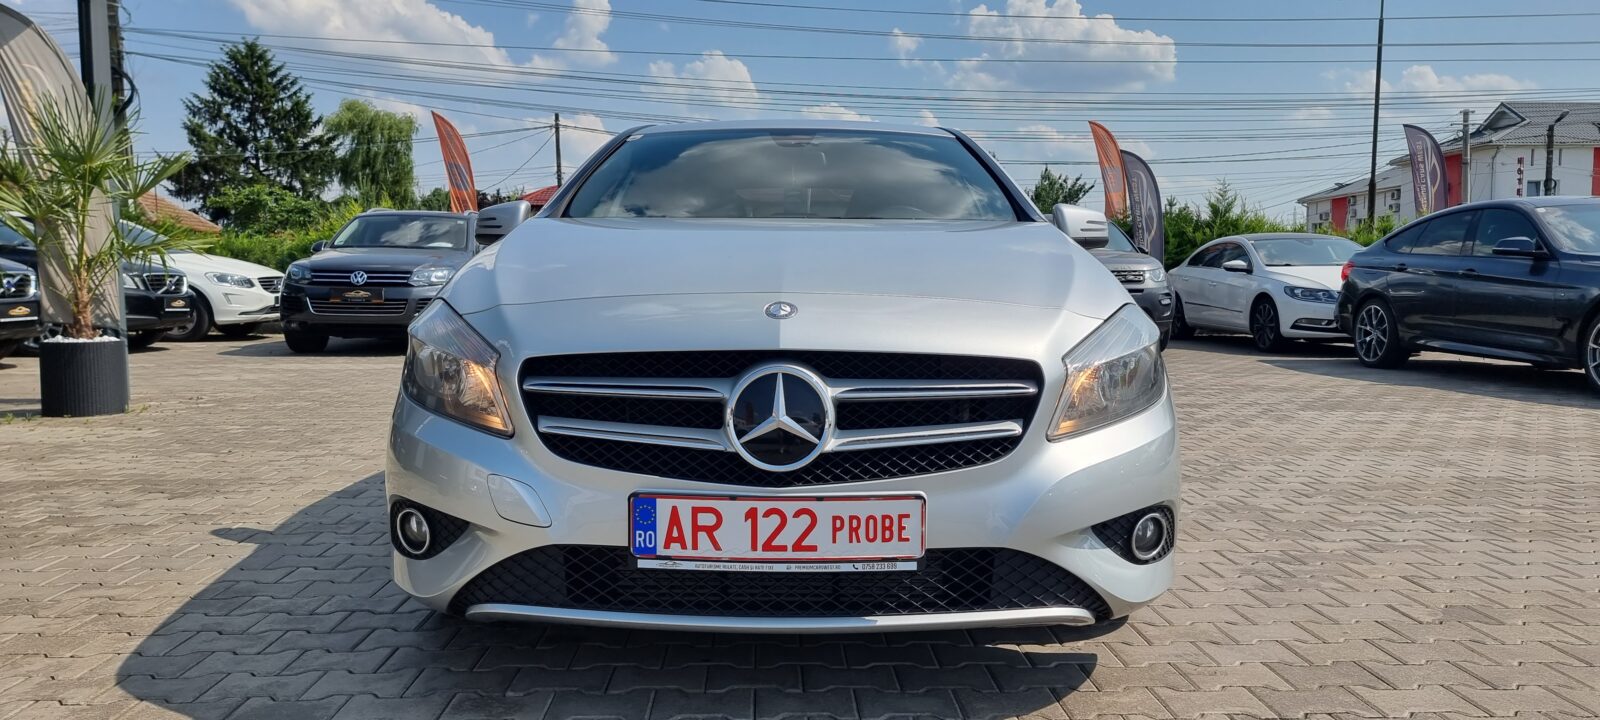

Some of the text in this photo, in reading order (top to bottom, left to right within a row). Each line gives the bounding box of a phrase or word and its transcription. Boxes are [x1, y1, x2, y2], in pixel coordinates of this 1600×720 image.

[636, 530, 655, 548] RO
[663, 505, 911, 552] AR 122 PROBE
